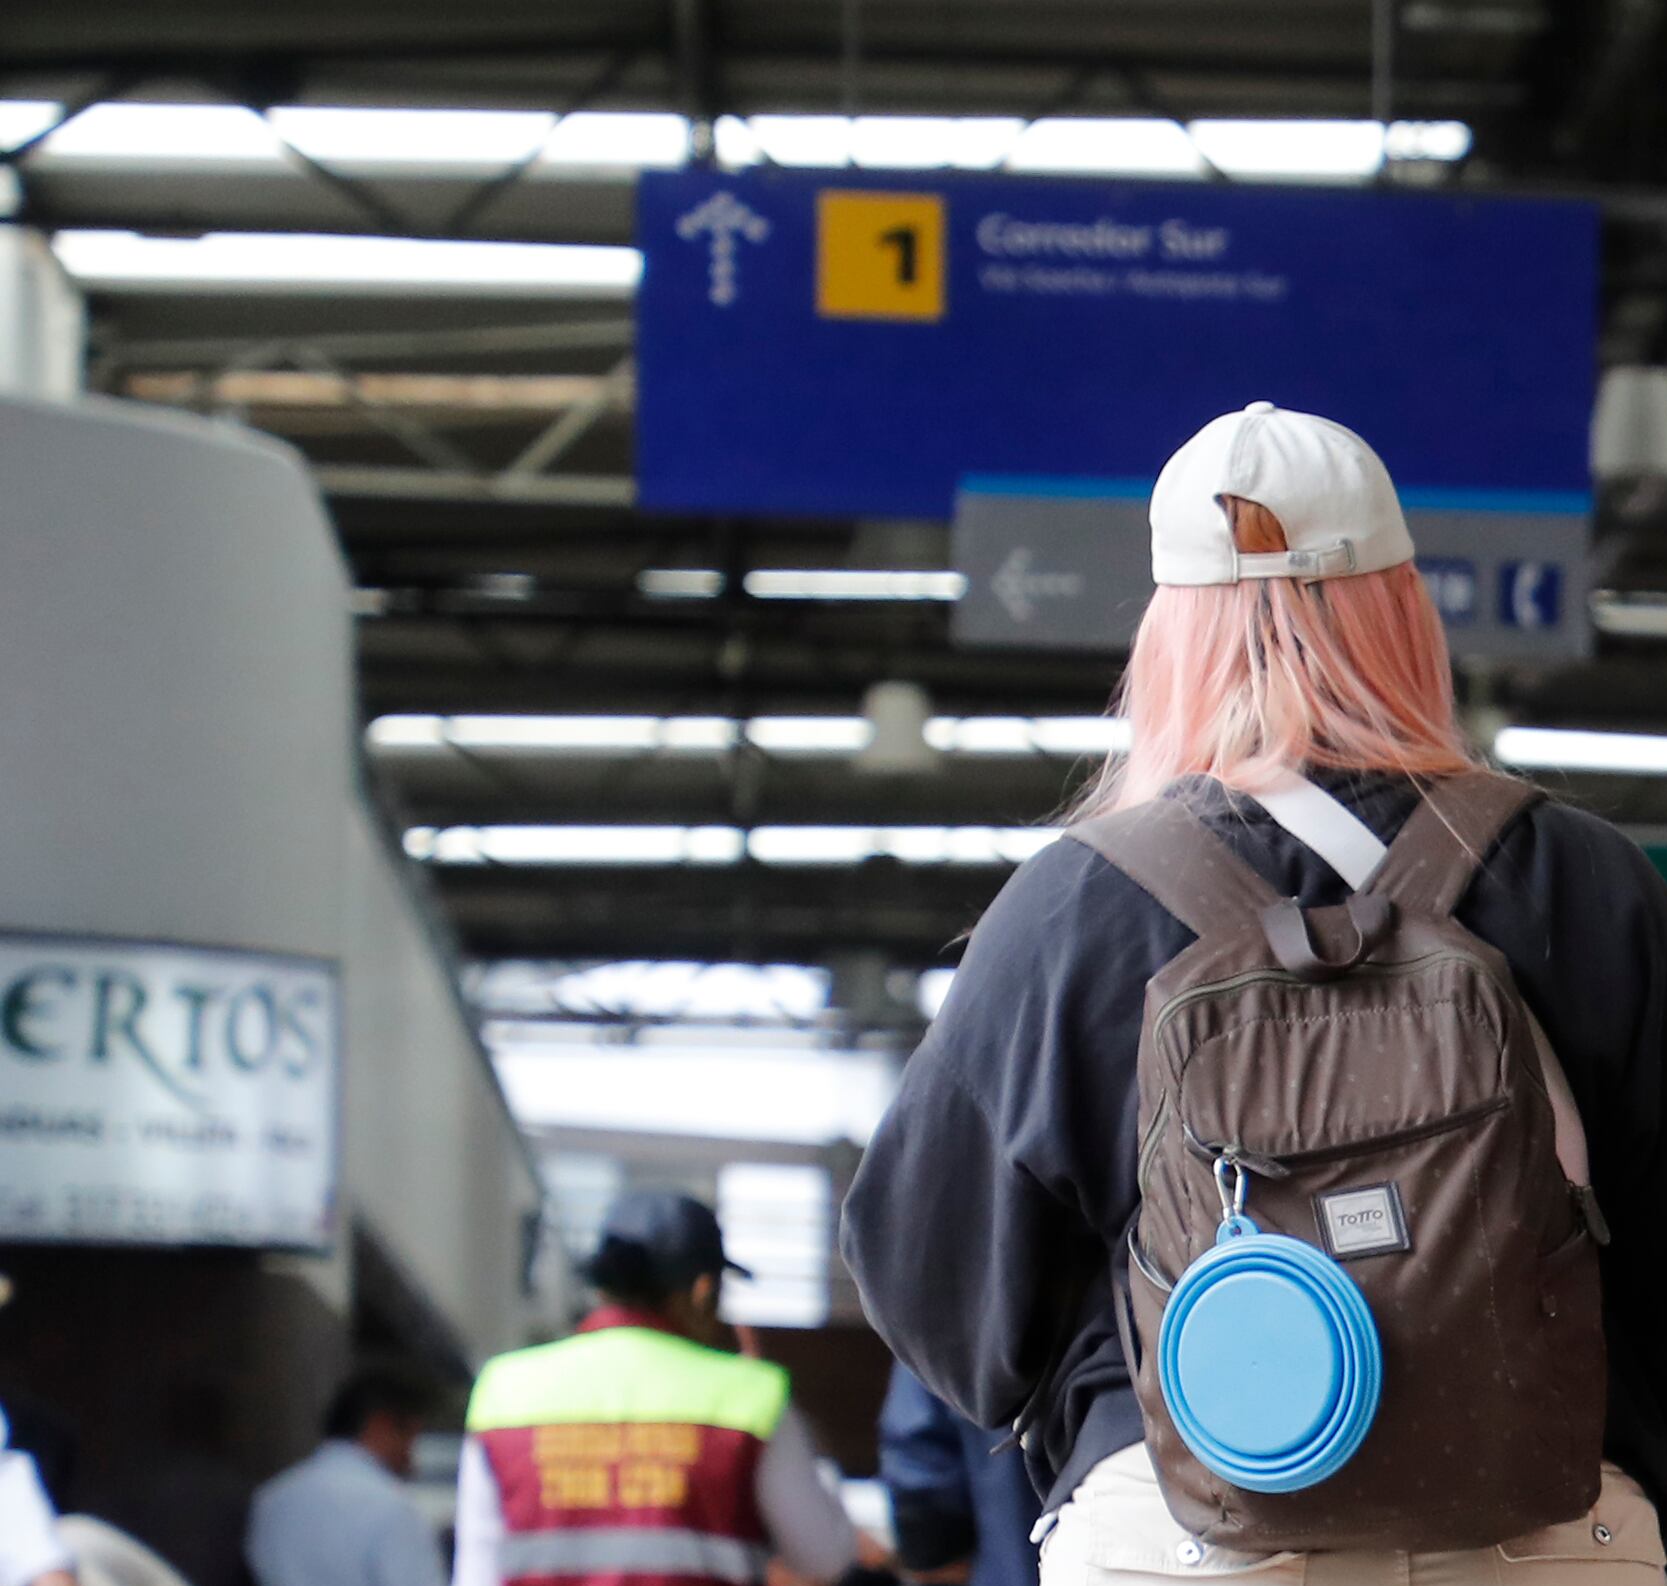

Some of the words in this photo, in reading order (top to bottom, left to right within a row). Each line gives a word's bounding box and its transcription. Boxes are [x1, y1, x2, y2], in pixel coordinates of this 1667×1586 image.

[877, 226, 919, 287] 1
[975, 212, 1151, 256] Corredor
[1158, 217, 1229, 260] Sur
